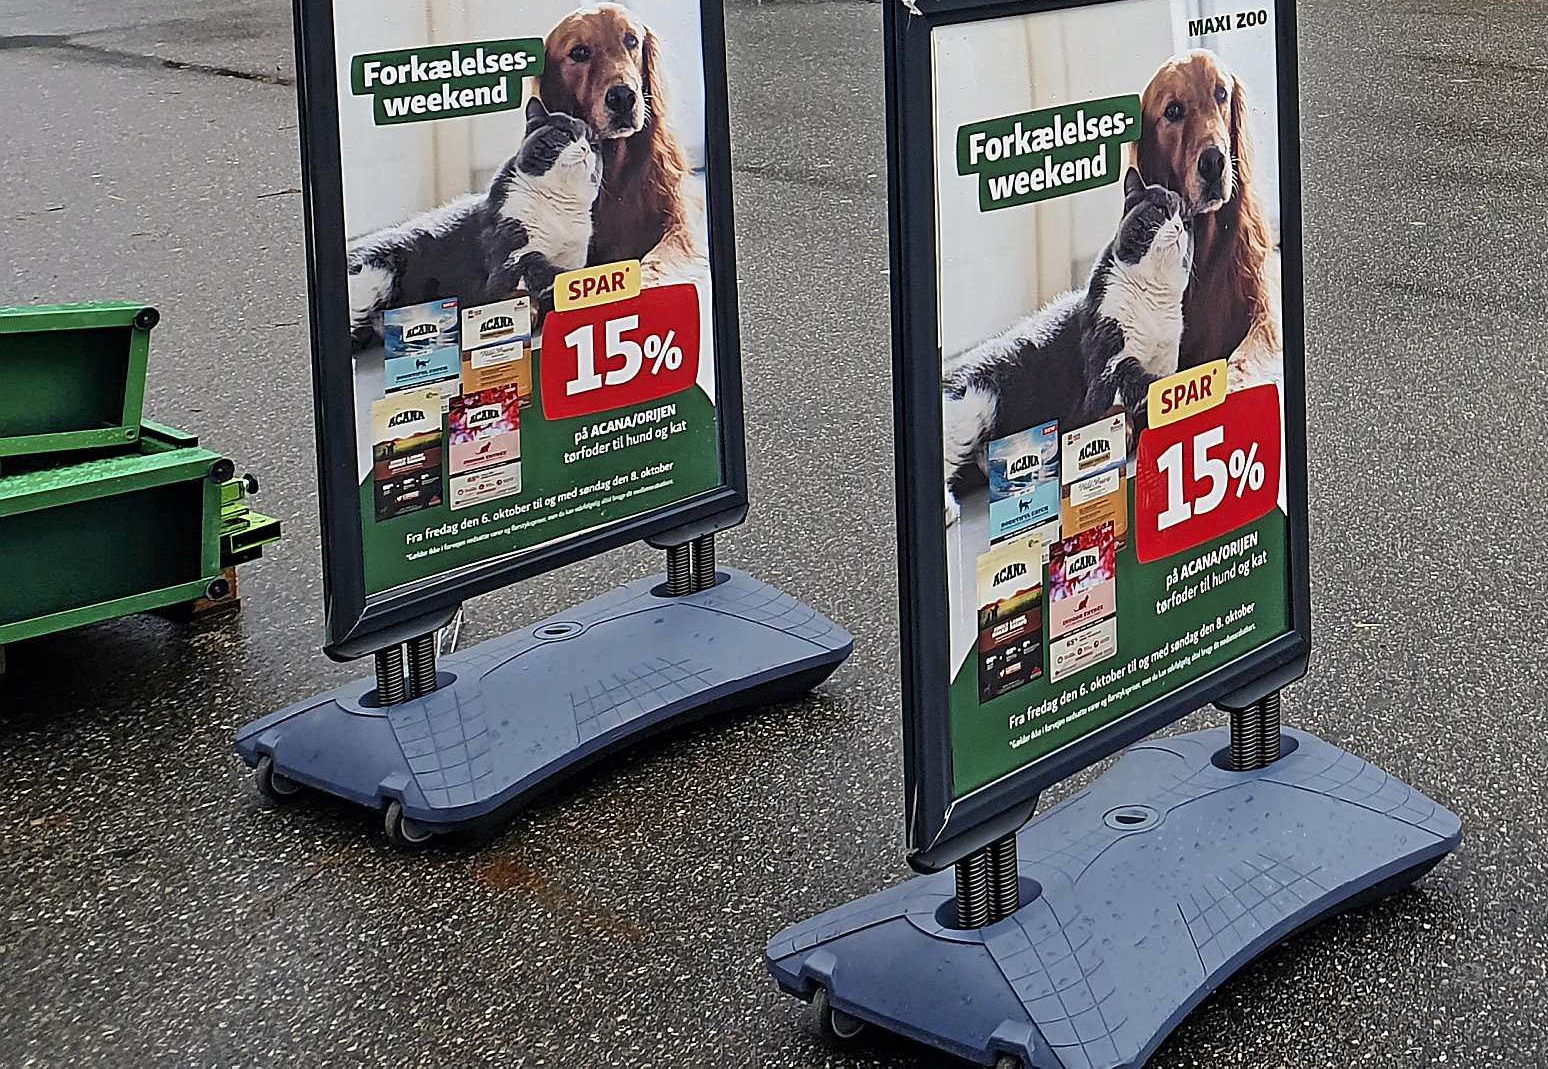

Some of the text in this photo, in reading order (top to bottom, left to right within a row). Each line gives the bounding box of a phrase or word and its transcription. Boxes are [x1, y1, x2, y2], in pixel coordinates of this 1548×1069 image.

[1188, 9, 1267, 37] MAXI ZOO
[363, 46, 537, 87] Forkælelses-
[382, 78, 509, 118] weekend
[969, 110, 1134, 165] Forkælelses-
[988, 143, 1107, 202] weekend
[405, 324, 438, 339] ACANA
[479, 316, 514, 332] ACANA
[564, 314, 683, 396] 15%
[388, 410, 426, 428] ACANA
[469, 409, 500, 424] ACANA
[574, 403, 676, 444] på ACANA/ORIJEN
[563, 419, 687, 464] tørfoder til hund og kat
[1078, 439, 1111, 461] ACANA
[1009, 454, 1039, 475] ACANA
[1157, 425, 1265, 531] 15%
[406, 462, 674, 545] Fra fredag den 6. oktober til og med søndag den 8. oktober
[992, 562, 1027, 587] ACANA
[1068, 554, 1098, 575] ACANA
[1165, 530, 1258, 591] på ACANA/ORIJEN
[1155, 550, 1268, 615] tørfoder til hund og kat
[1009, 602, 1256, 729] Fra fredag den 6. oktober til og med søndag den 8. oktober
